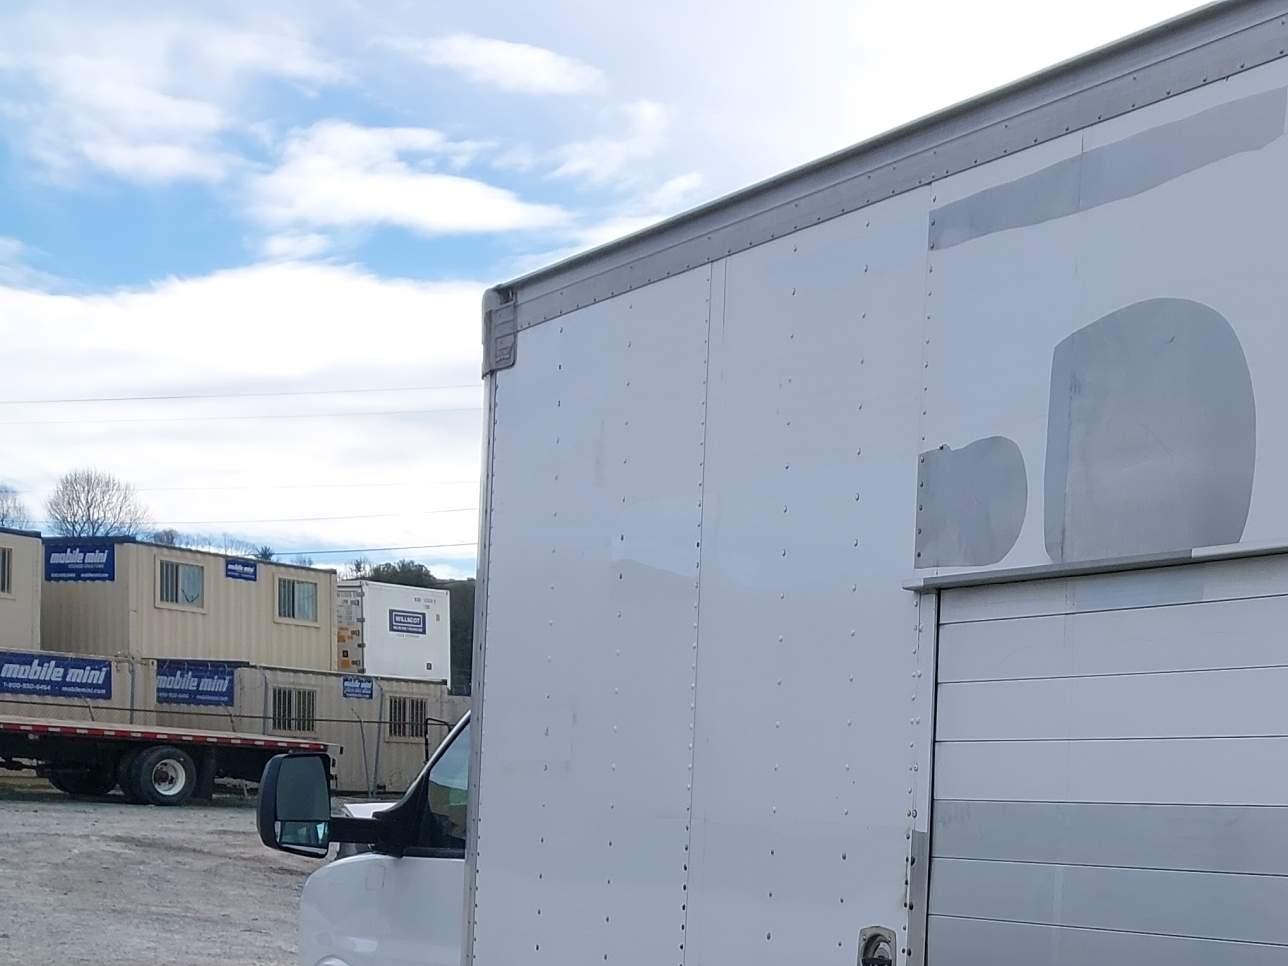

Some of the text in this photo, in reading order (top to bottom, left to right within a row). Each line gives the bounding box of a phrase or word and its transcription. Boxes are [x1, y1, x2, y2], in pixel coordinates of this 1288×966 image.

[50, 547, 109, 564] mobile mini
[0, 659, 108, 685] mobile mini
[156, 670, 231, 692] mobile mini
